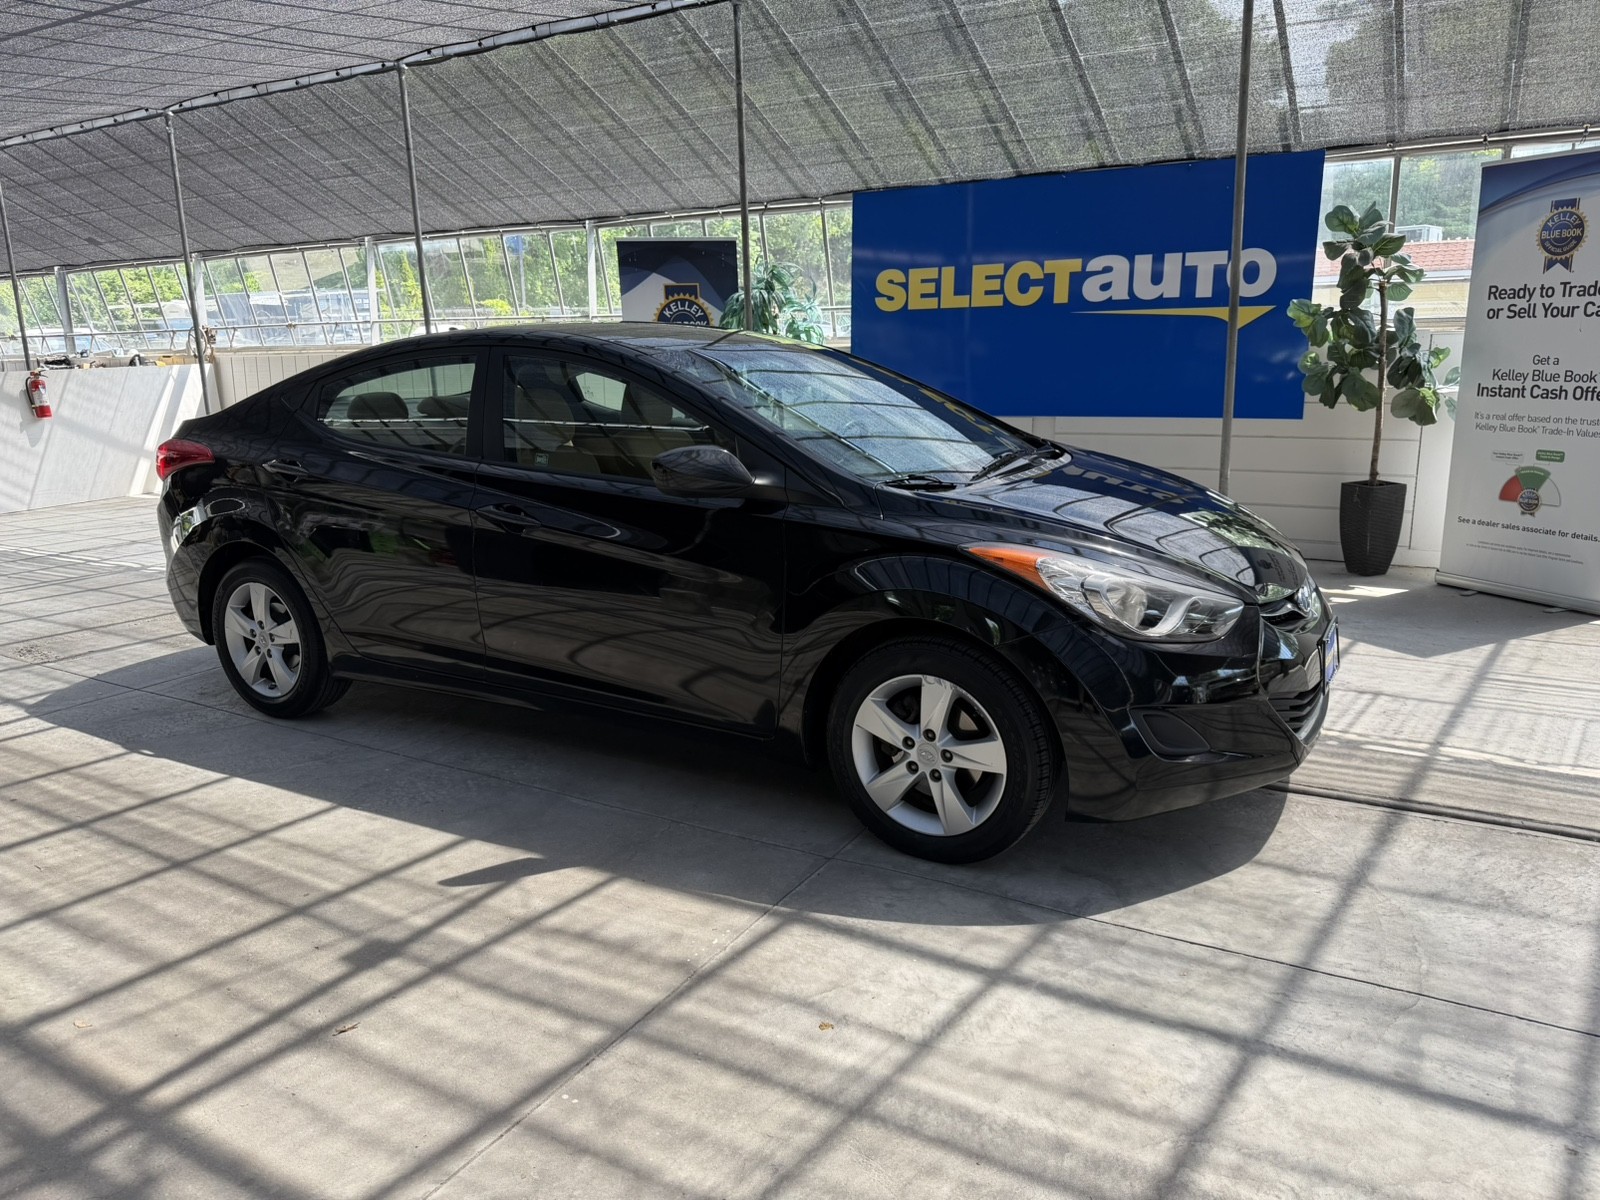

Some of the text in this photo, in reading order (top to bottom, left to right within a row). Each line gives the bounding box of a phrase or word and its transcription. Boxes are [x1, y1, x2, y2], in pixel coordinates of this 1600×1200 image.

[1547, 213, 1581, 227] KELLEY
[1541, 227, 1583, 239] BLUE BOOK
[1488, 283, 1536, 302] Ready
[1539, 283, 1555, 298] to
[662, 300, 705, 318] KELLEY
[1486, 307, 1504, 320] or
[1506, 303, 1537, 319] Sell
[1541, 302, 1580, 319] Your
[1532, 354, 1560, 366] Get a
[1492, 368, 1529, 384] Kelley
[1531, 369, 1561, 382] Blue
[1476, 383, 1527, 399] Instant
[1530, 384, 1568, 400] Cash
[1474, 411, 1485, 420] It's
[1485, 413, 1491, 421] a
[1492, 412, 1507, 421] real
[1508, 413, 1526, 422] offer
[1527, 414, 1551, 424] based
[1552, 416, 1563, 424] on
[1565, 416, 1578, 425] the
[1475, 422, 1498, 433] Kelley
[1498, 423, 1516, 433] Blue
[1541, 426, 1574, 436] Trade-In
[1457, 515, 1471, 524] See
[1477, 519, 1500, 528] dealer
[1501, 522, 1520, 531] sales
[1521, 526, 1557, 536] associate
[1558, 529, 1570, 538] for
